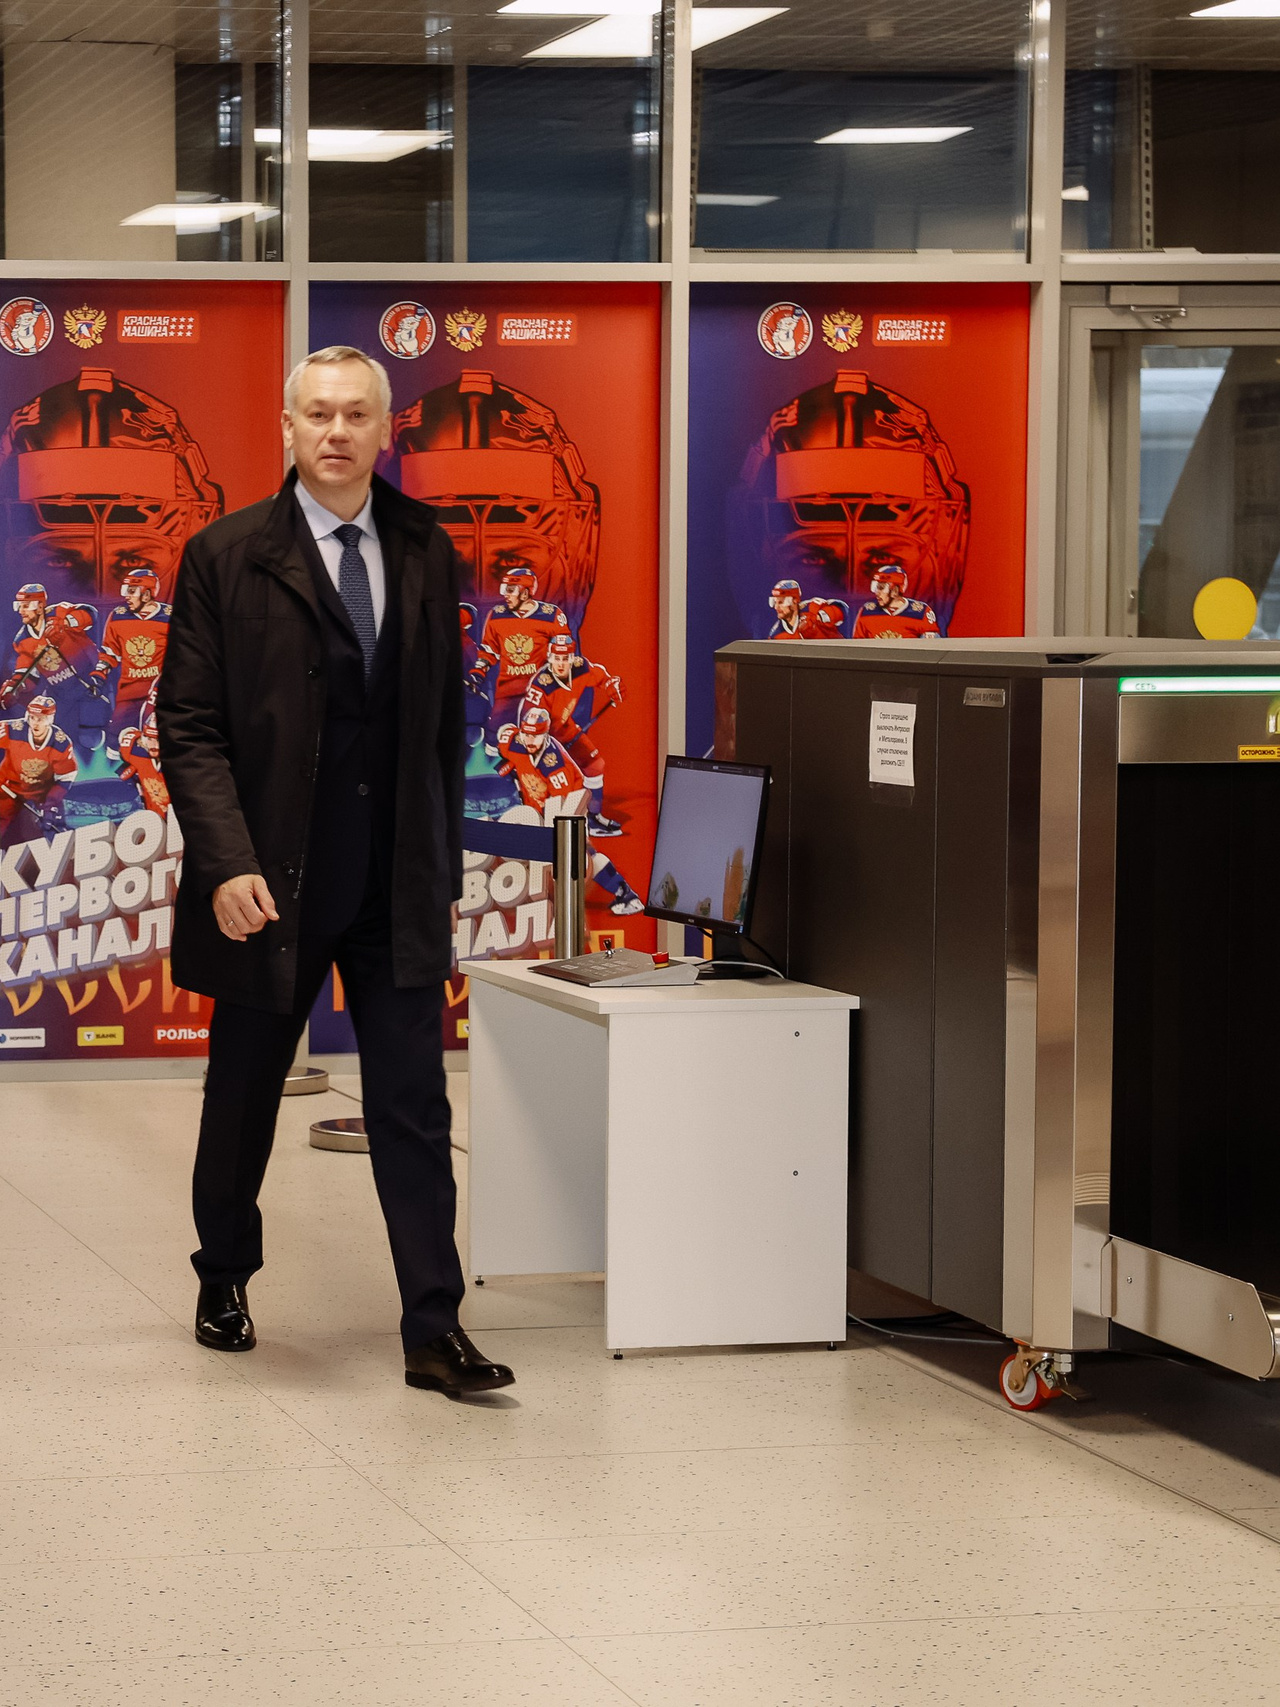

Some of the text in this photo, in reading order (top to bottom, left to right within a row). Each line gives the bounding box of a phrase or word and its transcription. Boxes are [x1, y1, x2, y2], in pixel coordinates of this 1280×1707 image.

[124, 316, 170, 325] КРАСНАЯ
[503, 319, 549, 328] КРАСНАЯ
[121, 325, 168, 337] МАШИНА
[501, 328, 547, 340] МАШИНА
[1135, 683, 1157, 691] СЕТЬ
[148, 691, 159, 706] 5
[527, 688, 543, 706] 53
[549, 771, 569, 789] 89
[156, 1028, 210, 1041] РОЛЬФ
